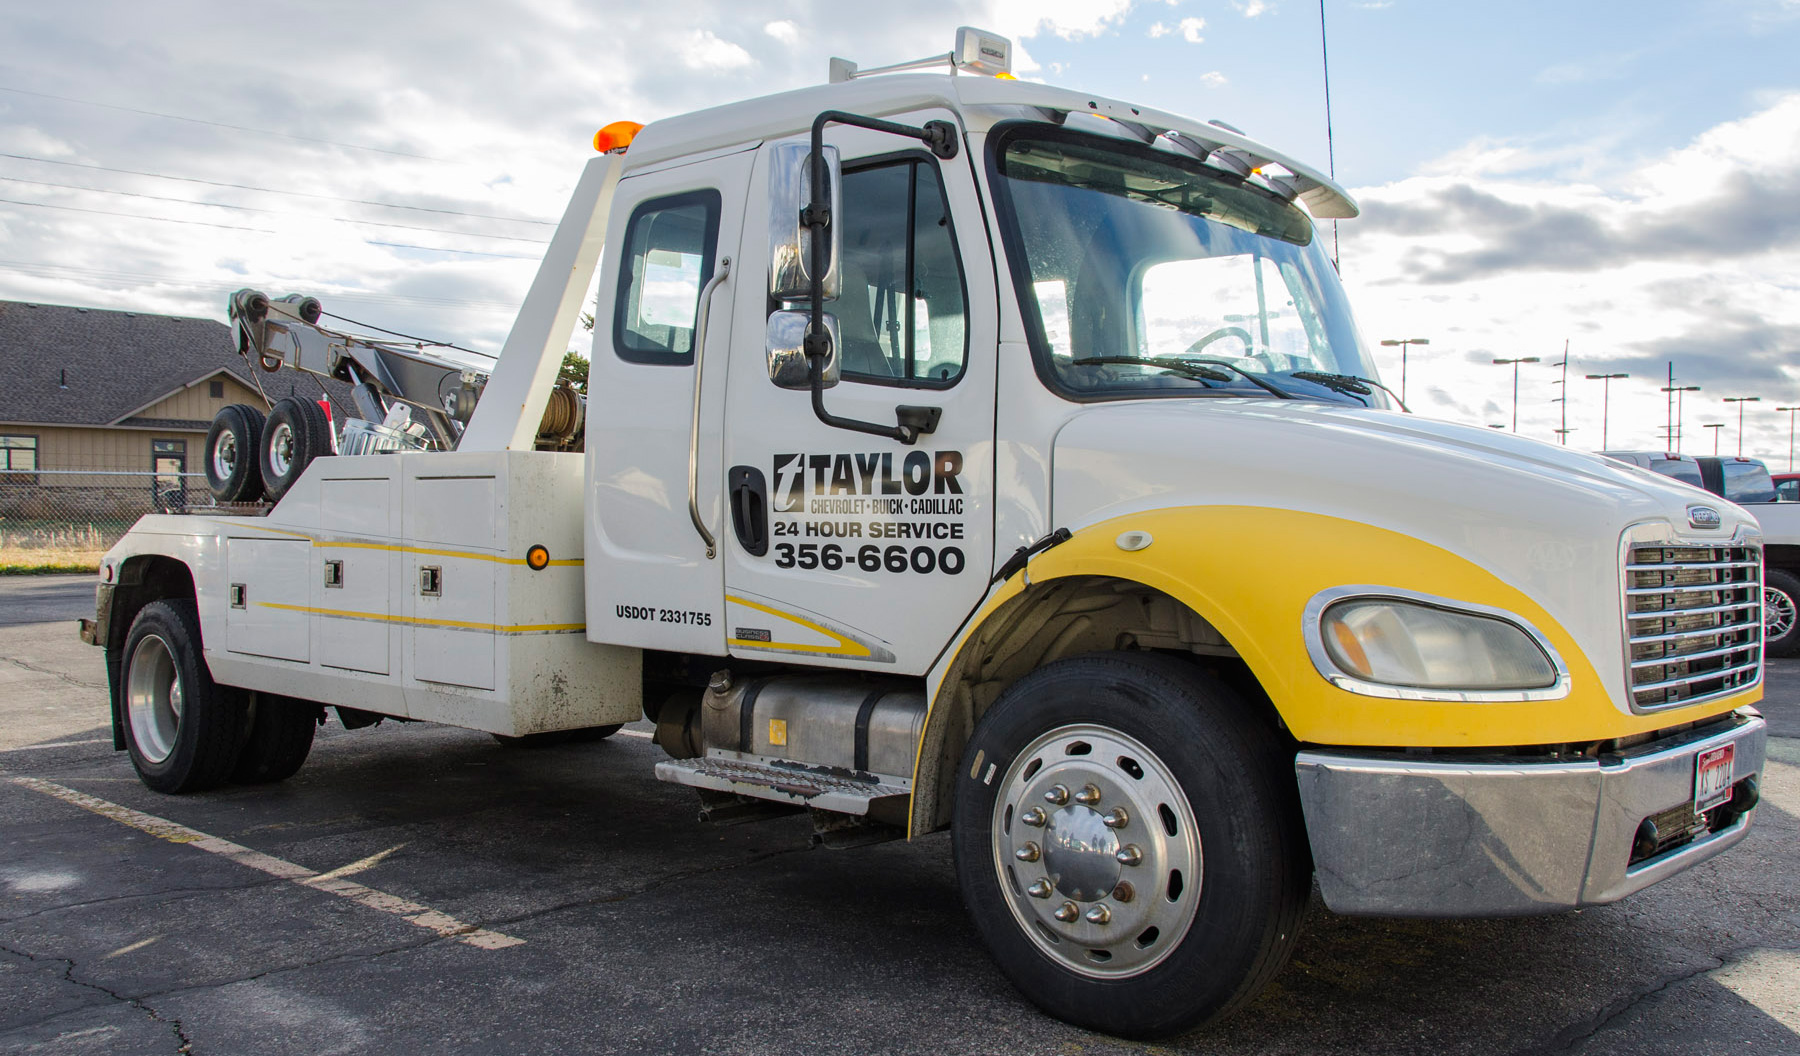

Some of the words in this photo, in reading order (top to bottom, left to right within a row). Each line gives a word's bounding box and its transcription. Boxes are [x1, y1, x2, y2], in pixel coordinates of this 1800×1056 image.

[809, 450, 963, 496] TAYLOR
[810, 498, 865, 515] CHEVROLET
[872, 498, 903, 515] BUICK
[910, 498, 963, 515] CADILLAC
[774, 521, 799, 537] 24
[806, 521, 862, 538] HOUR
[868, 521, 964, 539] SERVICE
[774, 543, 965, 575] 356-6600
[616, 604, 656, 621] USDOT
[659, 609, 712, 626] 2331755
